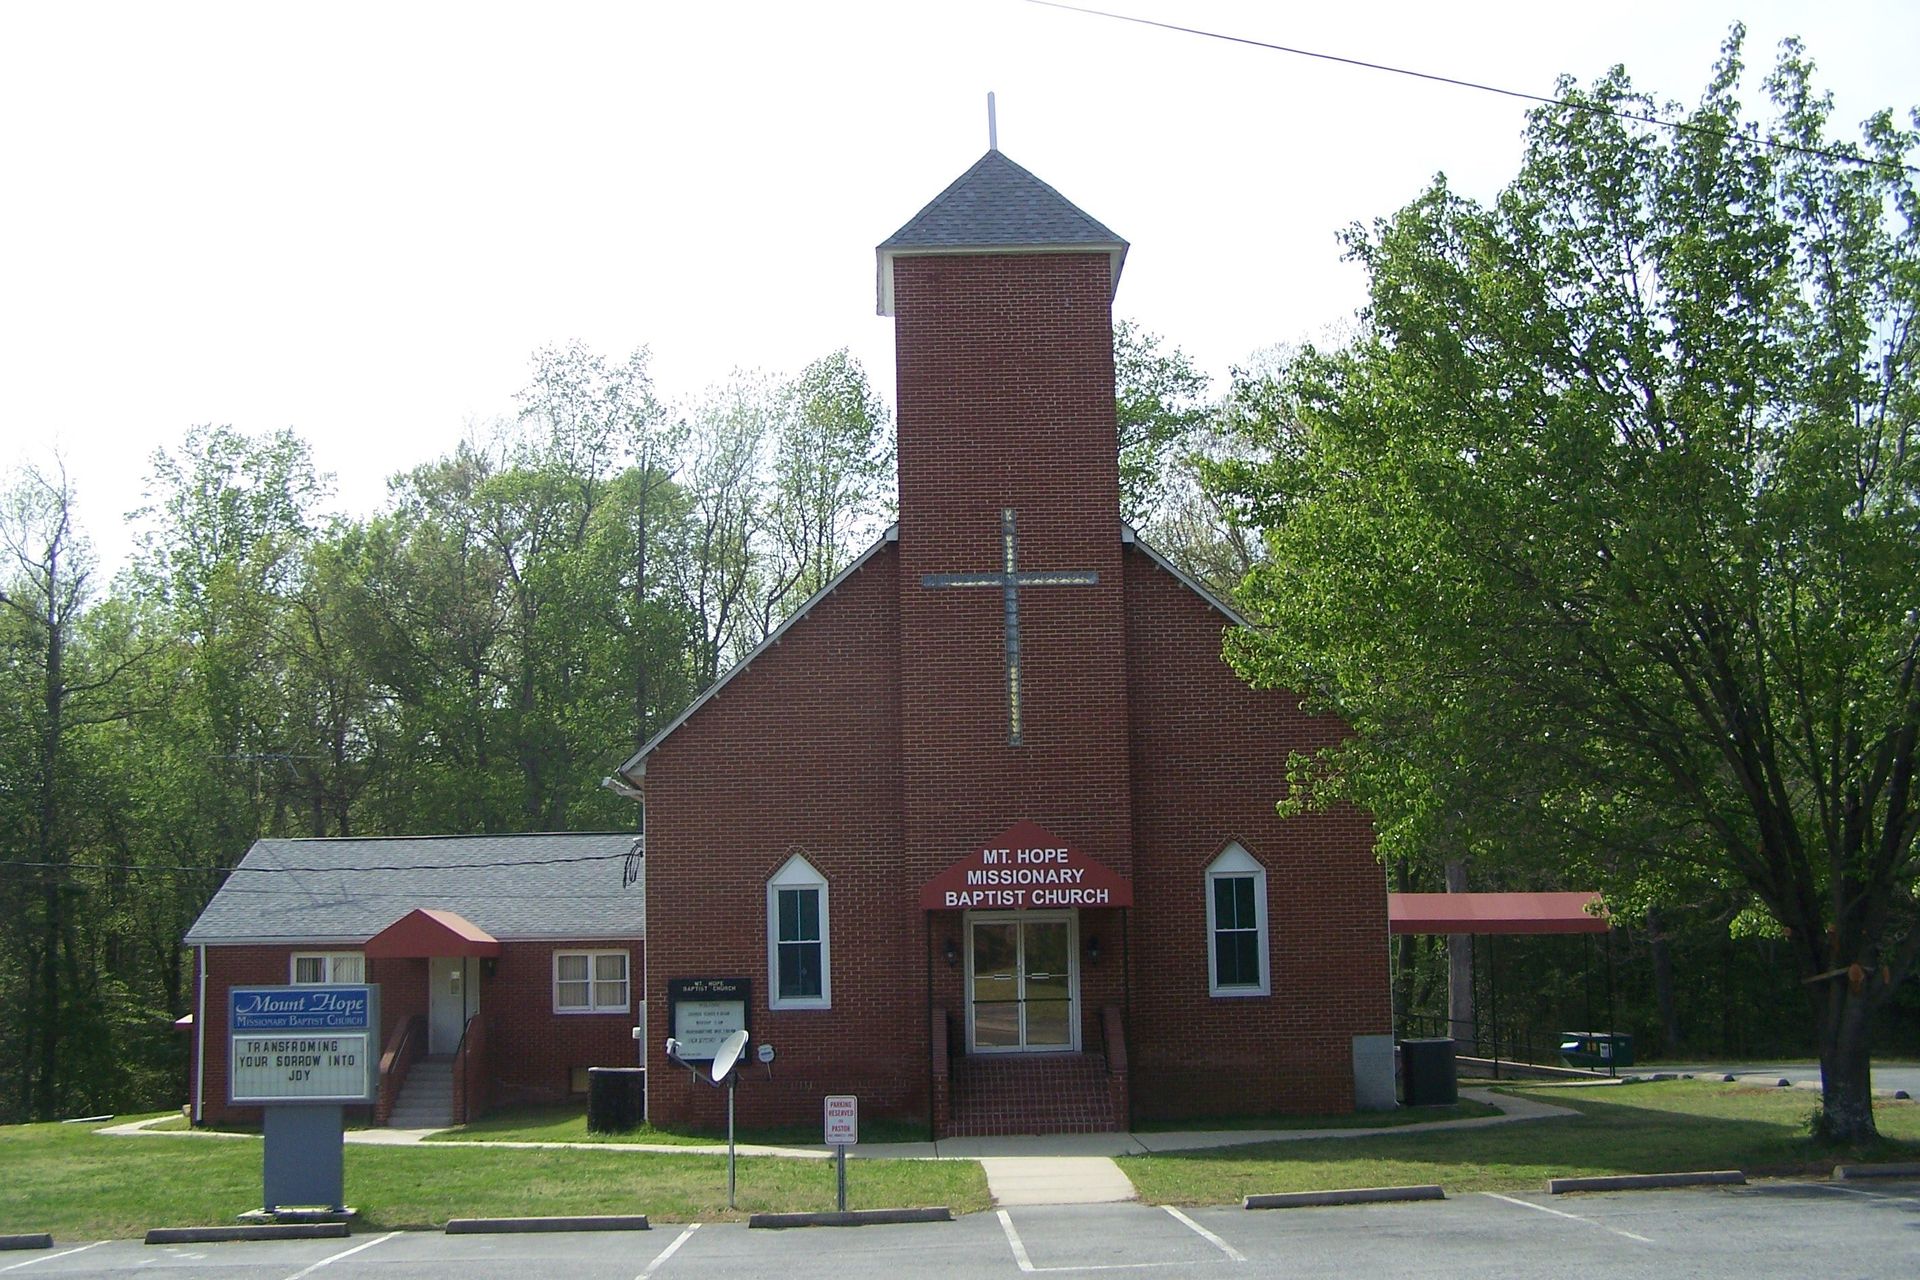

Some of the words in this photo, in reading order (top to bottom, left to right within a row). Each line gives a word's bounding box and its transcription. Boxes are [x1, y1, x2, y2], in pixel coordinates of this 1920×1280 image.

[983, 849, 1012, 864] MT.
[1017, 848, 1069, 864] HOPE
[967, 868, 1084, 885] MISSIONARY
[945, 889, 1026, 906] BAPTIST
[1031, 888, 1109, 905] CHURCH
[236, 995, 305, 1012] Mount
[309, 994, 364, 1015] Hope
[247, 1040, 339, 1053] TRANSFROMING
[239, 1056, 268, 1068] YOUR
[276, 1055, 321, 1067] SORROW
[328, 1054, 355, 1067] INTO
[288, 1070, 311, 1082] JOY
